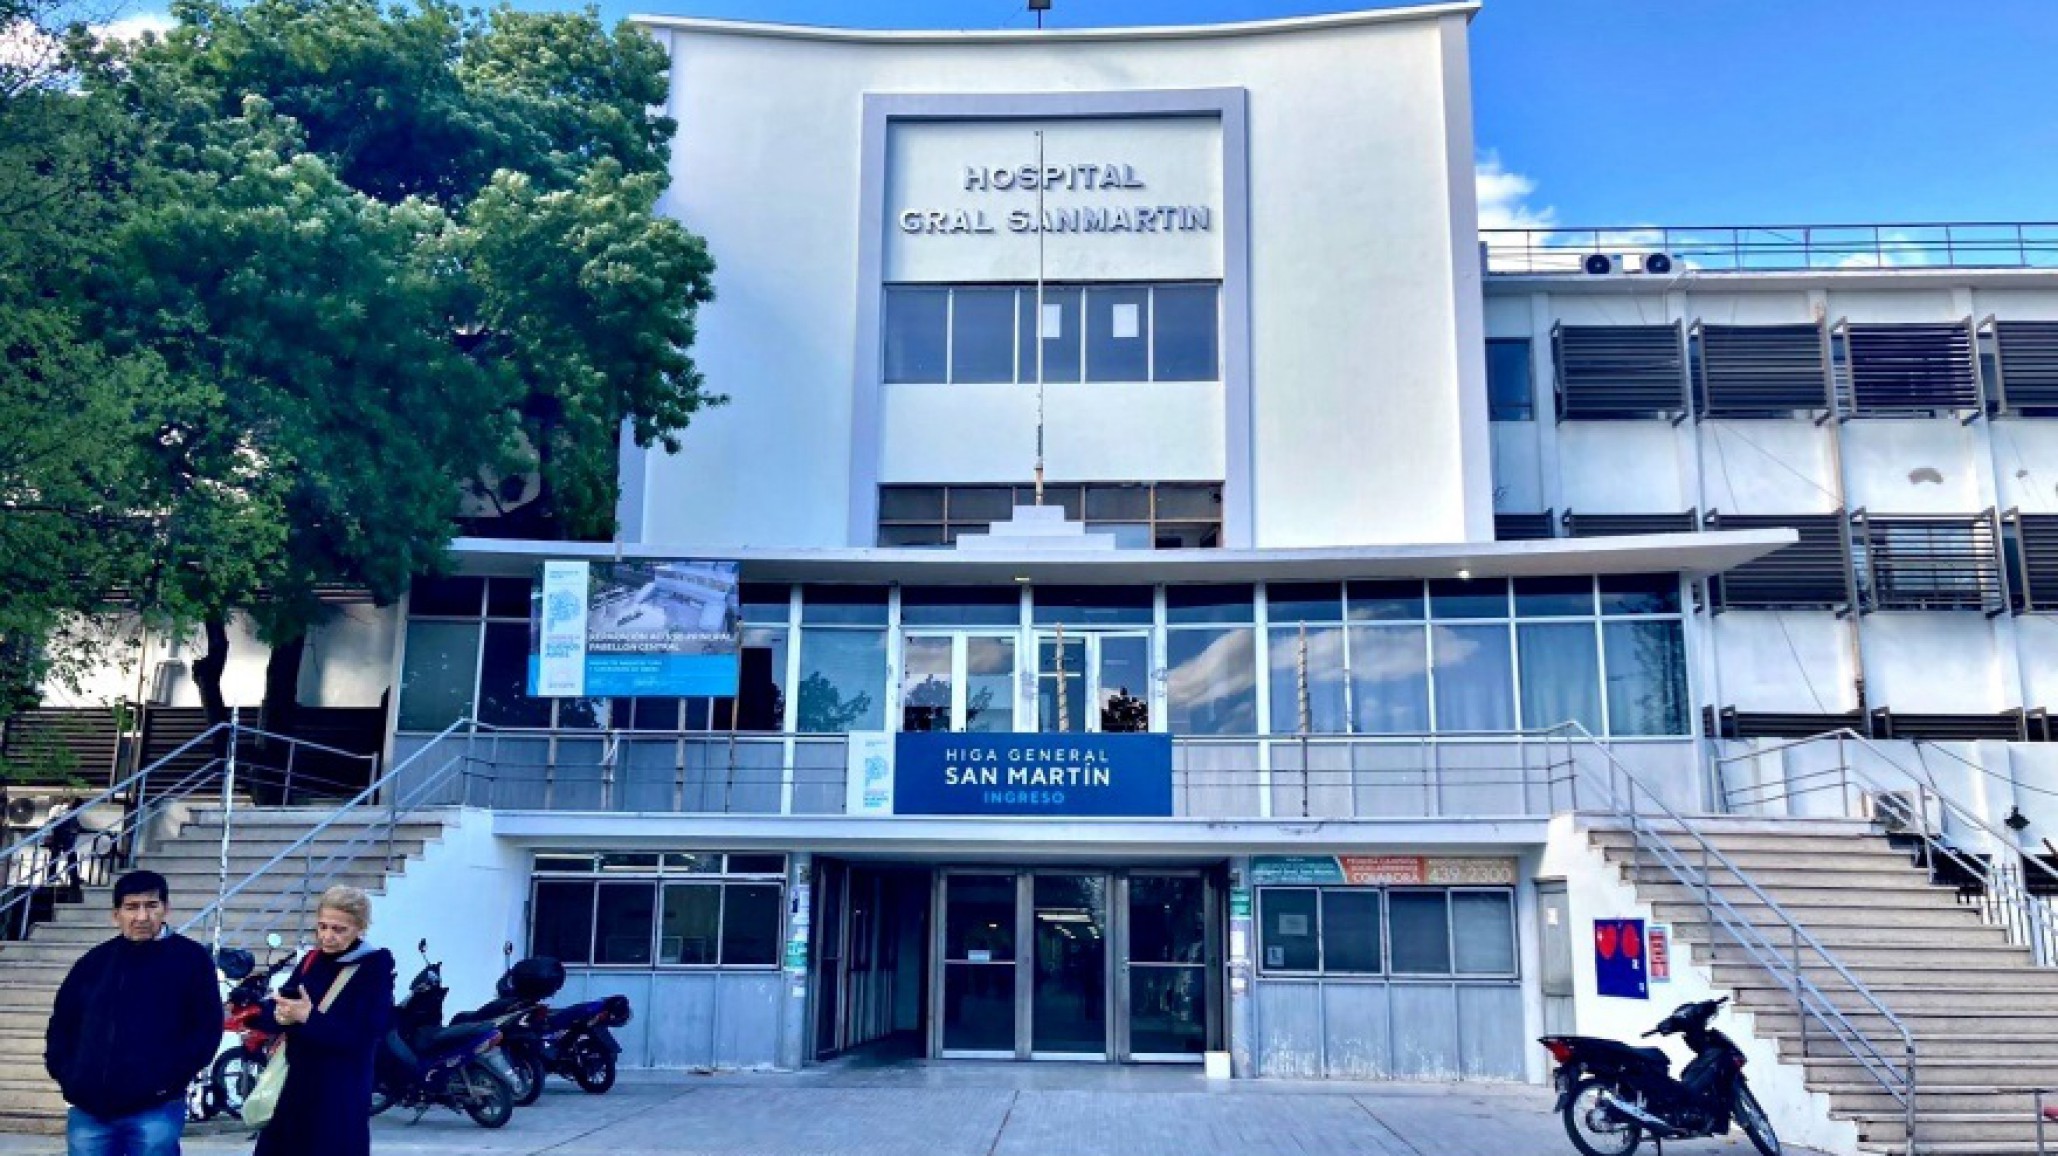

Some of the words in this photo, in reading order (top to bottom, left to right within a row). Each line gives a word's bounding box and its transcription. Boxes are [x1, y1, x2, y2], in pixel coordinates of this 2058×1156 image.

[964, 164, 1146, 191] HOSPITAL
[899, 208, 994, 235] GRAL
[1008, 206, 1212, 234] SANMARTIN
[946, 748, 998, 762] HIGA
[1008, 748, 1109, 762] GENERAL
[945, 767, 997, 785] SAN
[1007, 763, 1111, 786] MARTÍN
[984, 791, 1065, 804] INGRESO
